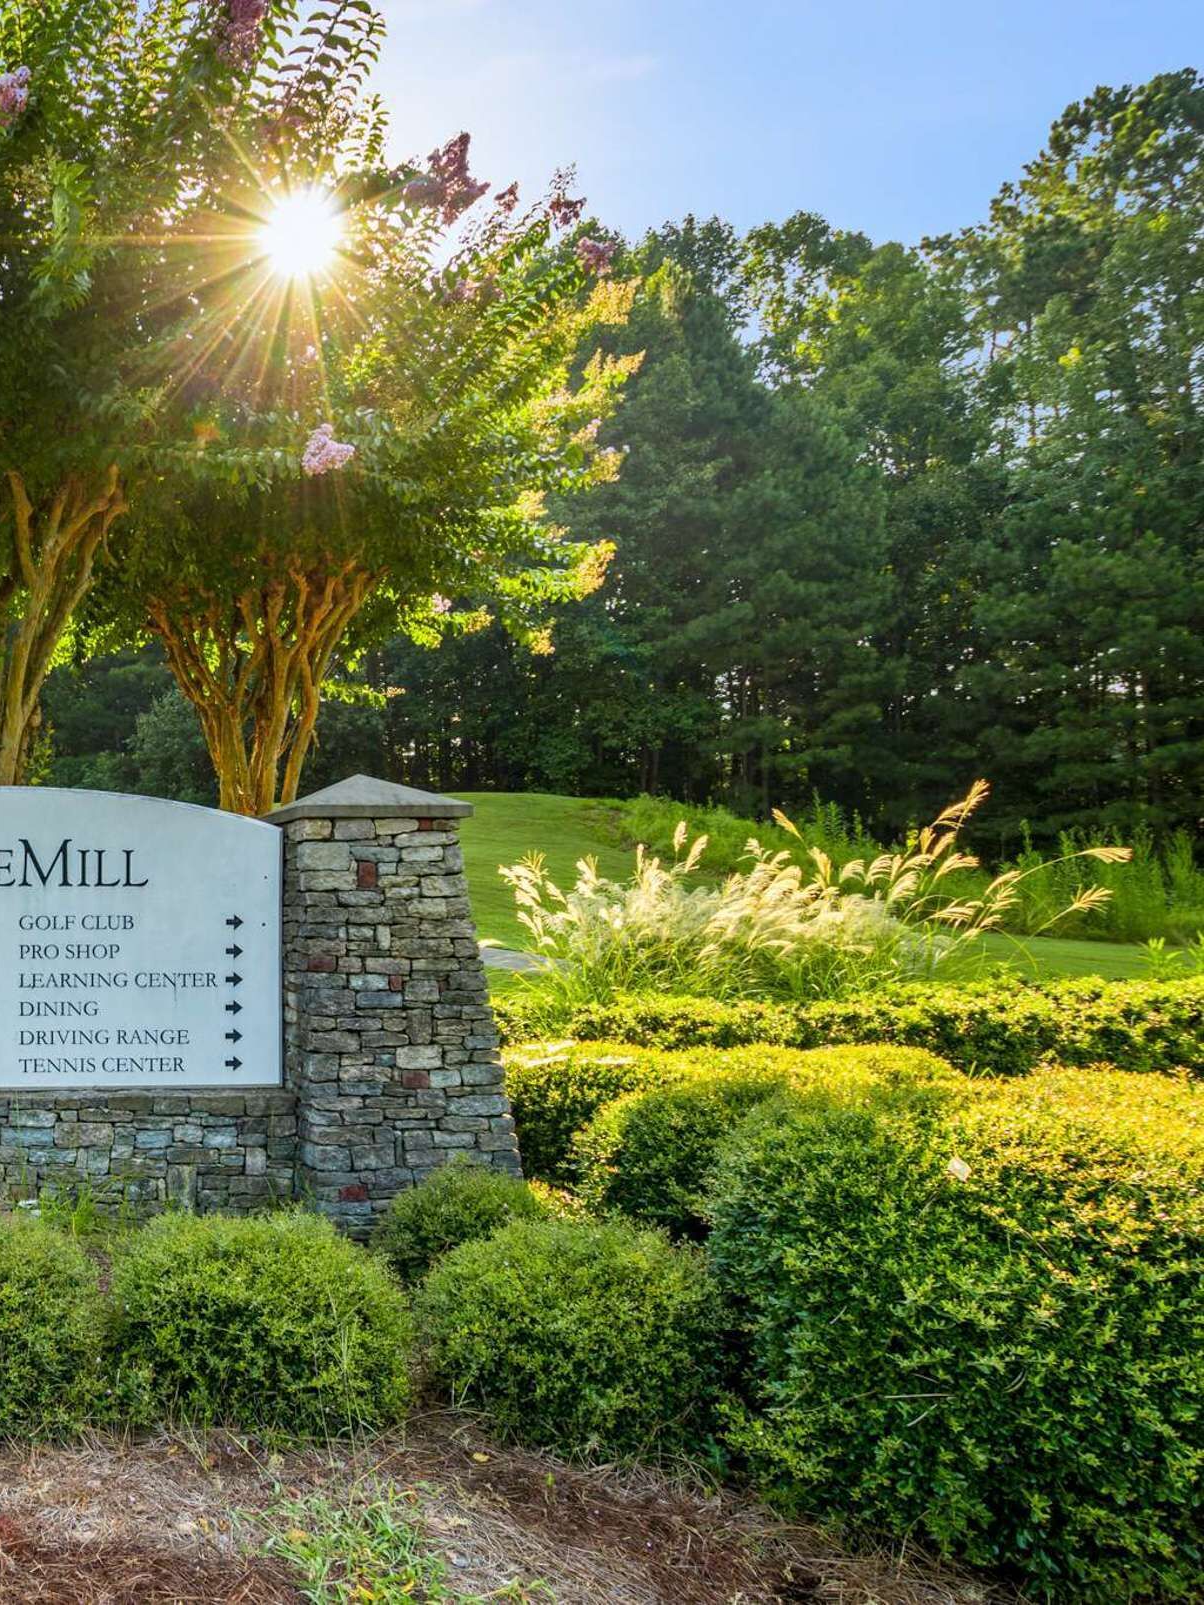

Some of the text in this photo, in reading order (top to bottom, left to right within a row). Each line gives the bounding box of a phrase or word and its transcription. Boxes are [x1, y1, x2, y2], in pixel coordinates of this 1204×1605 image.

[19, 915, 135, 931] GOLF CLUB
[19, 944, 121, 960] PRO SHOP
[19, 972, 218, 989] LEARNING CENTER
[19, 1001, 99, 1017] DINING
[19, 1029, 190, 1046] DRIVING RANGE
[19, 1057, 186, 1073] TENNIS CENTER
